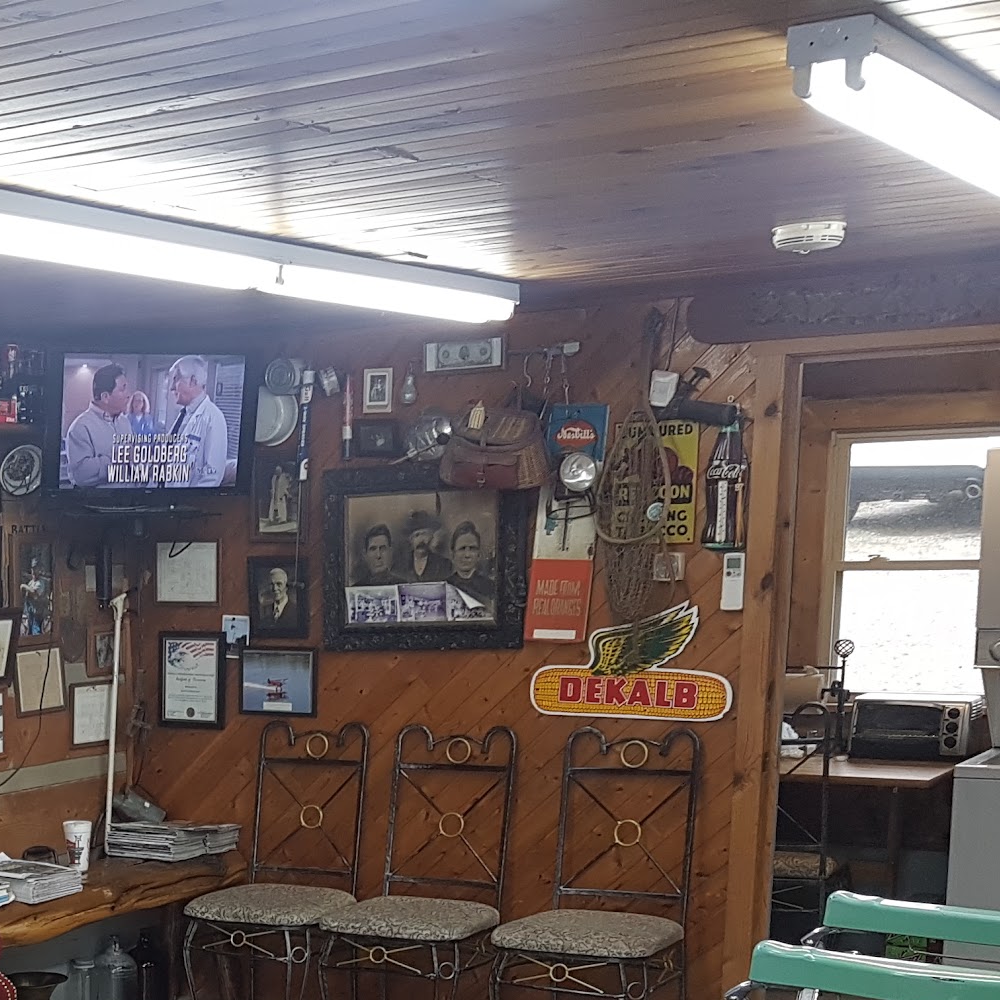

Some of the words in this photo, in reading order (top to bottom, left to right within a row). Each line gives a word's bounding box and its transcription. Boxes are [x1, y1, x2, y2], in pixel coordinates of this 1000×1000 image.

[112, 433, 152, 444] SUPERVISING
[153, 433, 189, 444] PRODUCERS
[111, 445, 130, 463] LEE
[133, 445, 187, 463] GOLDBERG
[107, 464, 149, 483] WILLIAM
[152, 464, 190, 483] RABKIN
[536, 579, 558, 596] MADE
[560, 580, 581, 596] FROM
[532, 598, 550, 616] REAL
[558, 675, 699, 710] DEKALB
